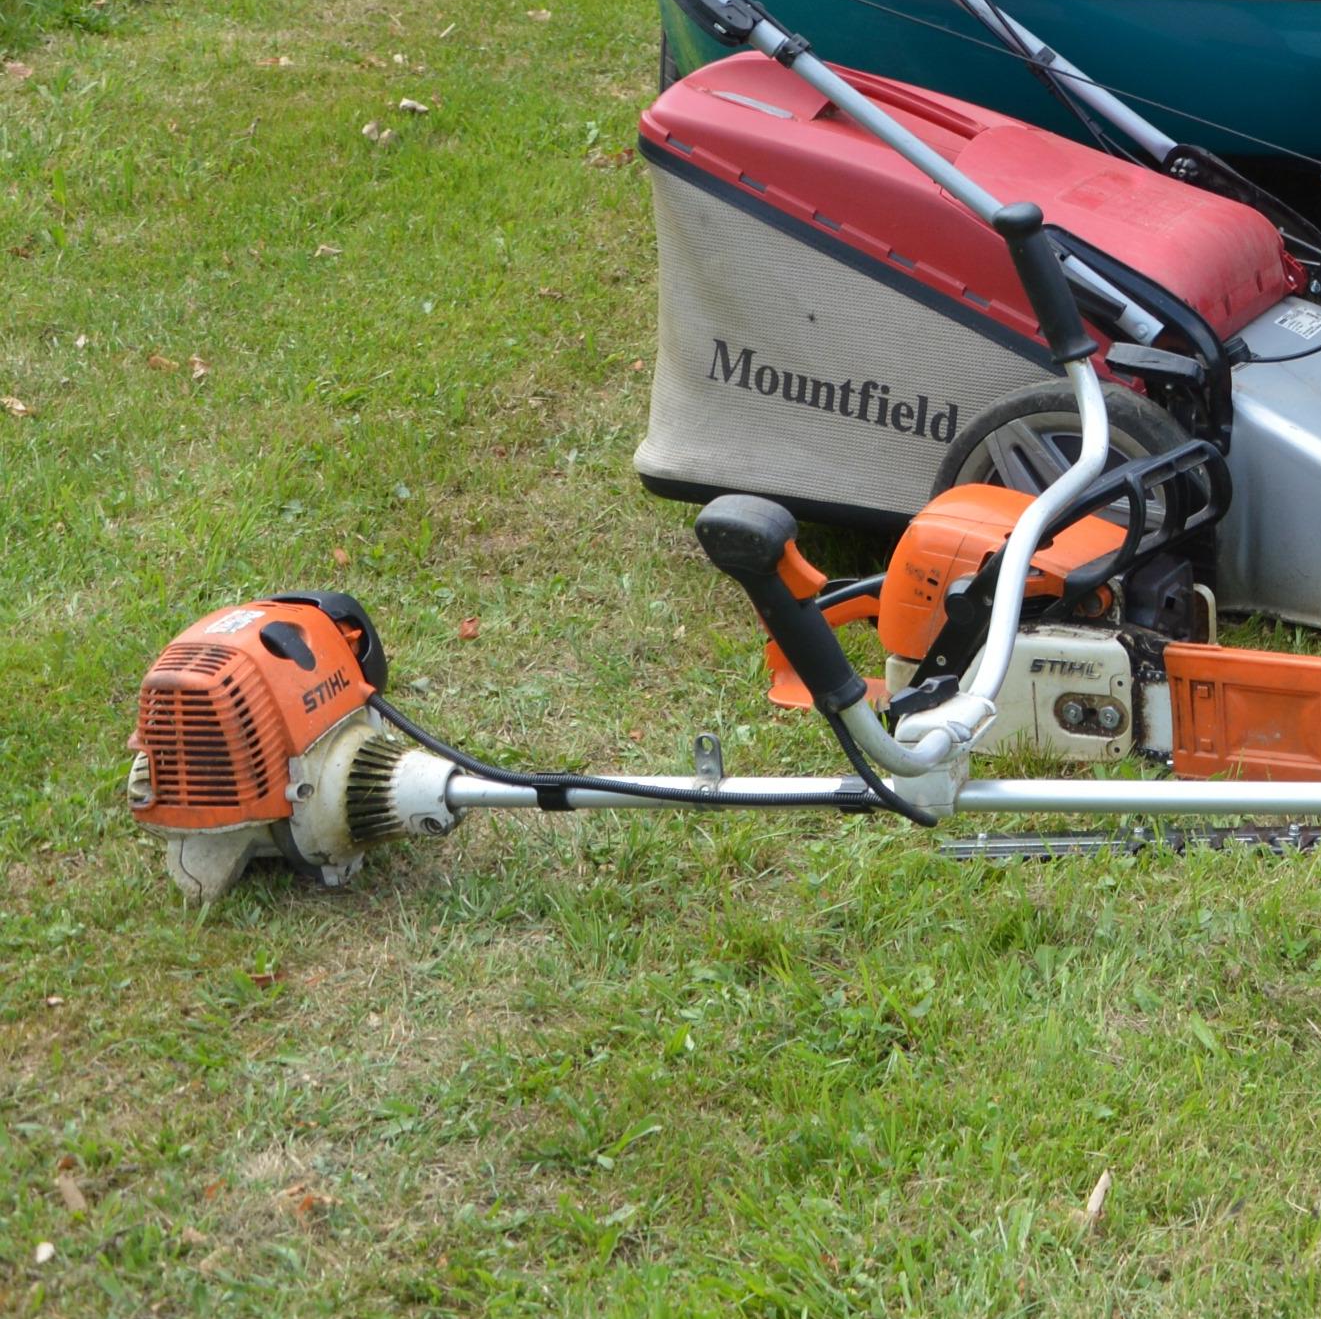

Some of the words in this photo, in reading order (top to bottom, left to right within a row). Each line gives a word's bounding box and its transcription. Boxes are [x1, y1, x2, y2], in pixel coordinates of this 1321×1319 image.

[706, 337, 960, 445] Mountfield
[302, 668, 350, 714] STIHL
[1030, 656, 1102, 680] STIHL
